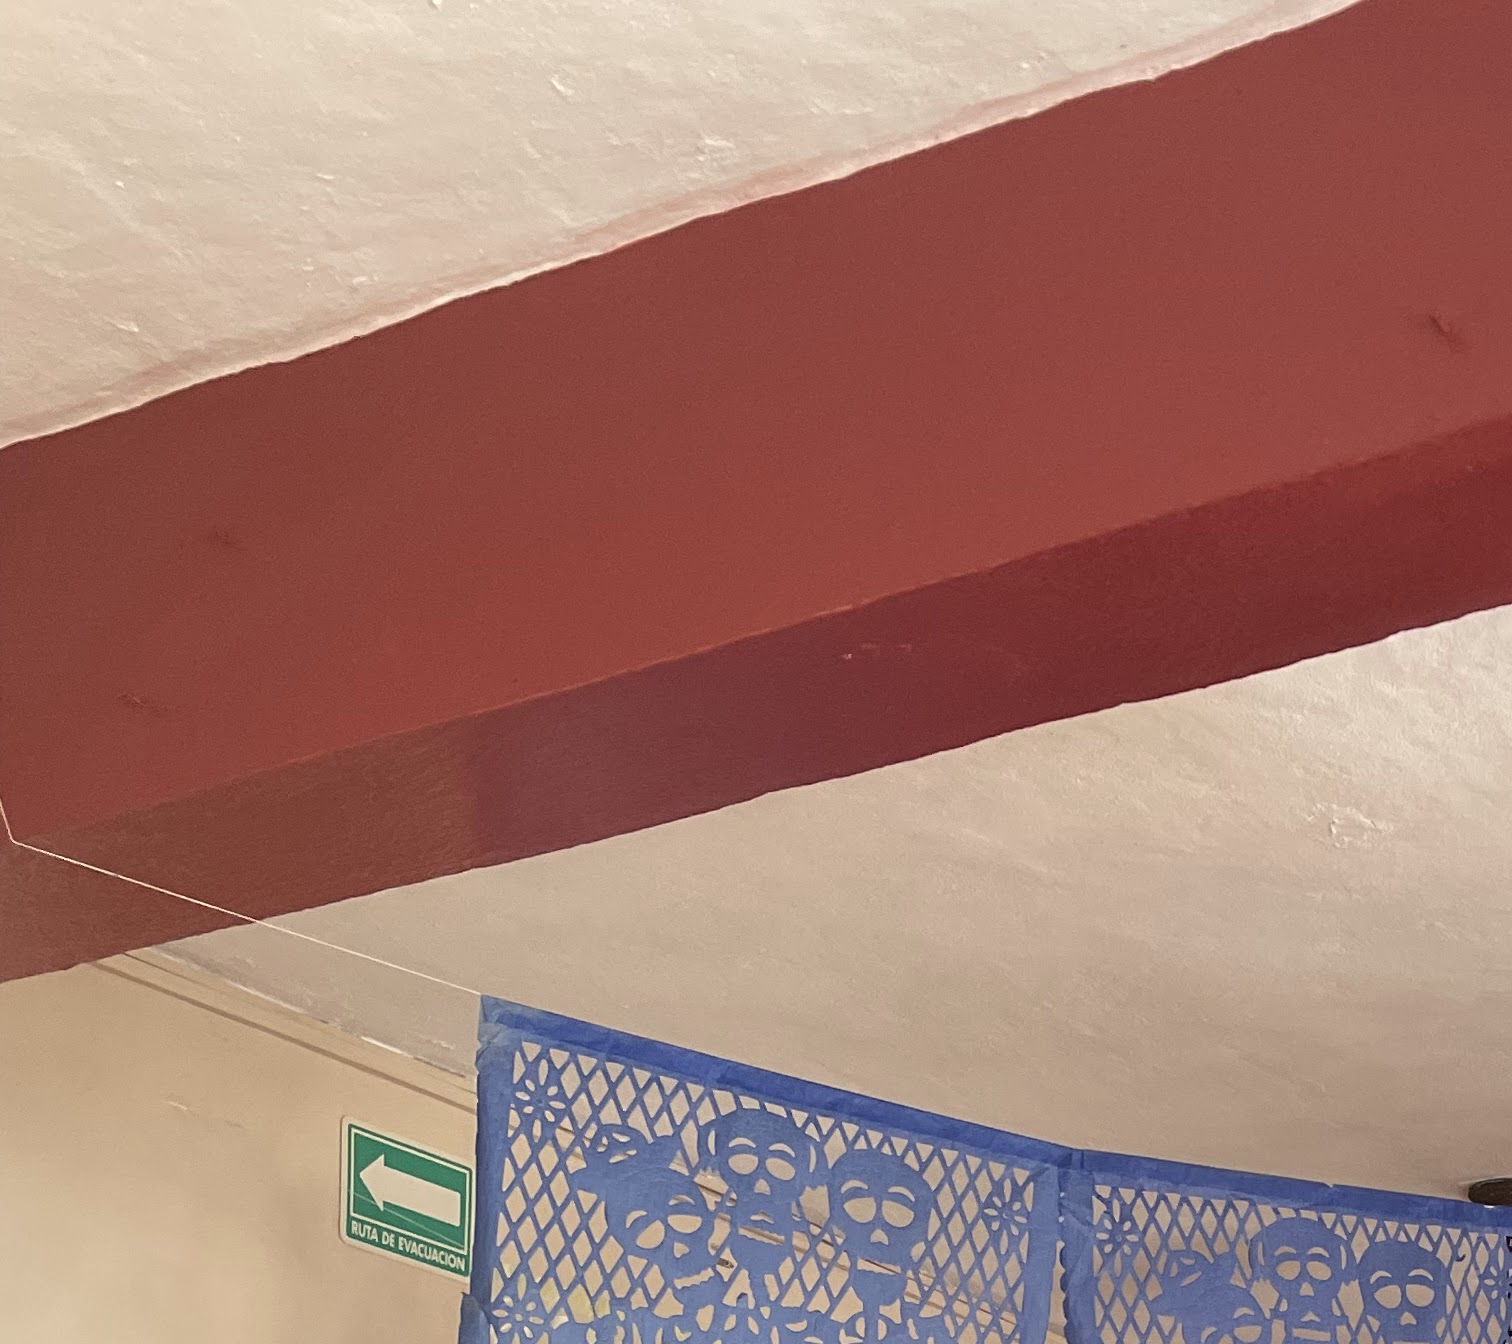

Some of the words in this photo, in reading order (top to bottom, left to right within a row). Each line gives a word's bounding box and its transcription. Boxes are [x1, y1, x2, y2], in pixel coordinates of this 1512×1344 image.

[351, 1220, 378, 1242] RUTA
[382, 1231, 395, 1248] DE
[398, 1237, 465, 1271] EVACUACION
